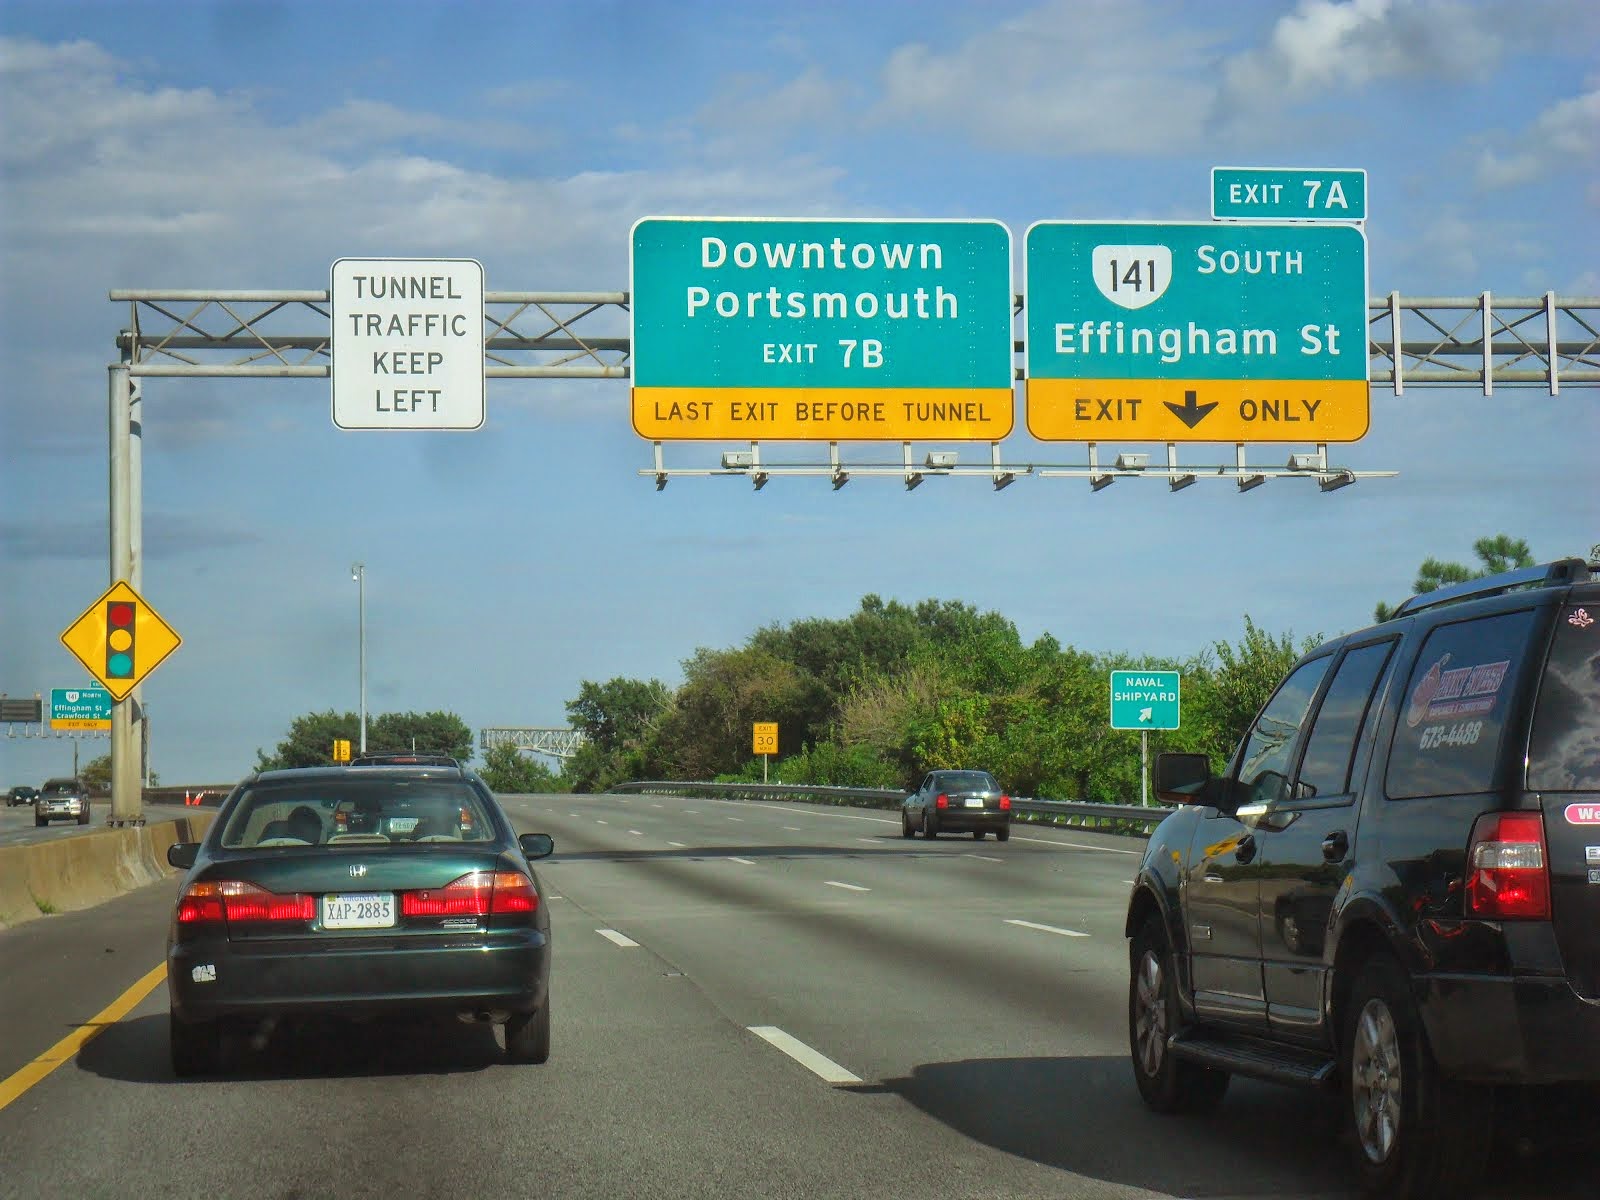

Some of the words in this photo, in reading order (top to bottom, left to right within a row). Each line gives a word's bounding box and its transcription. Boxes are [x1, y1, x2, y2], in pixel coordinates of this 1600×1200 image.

[1229, 183, 1283, 204] EXIT
[1303, 180, 1348, 209] 7A
[701, 236, 943, 269] Downtown
[1197, 245, 1303, 275] SOUTH
[353, 276, 462, 299] TUNNEL
[1110, 259, 1155, 292] 141
[687, 285, 959, 319] Portsmouth
[349, 313, 467, 337] TRAFFIC
[762, 343, 818, 363] EXIT
[838, 339, 884, 368] 7B
[1054, 320, 1277, 363] Effingham
[1300, 323, 1340, 355] St
[373, 351, 443, 375] KEEP
[376, 389, 441, 413] LEFT
[654, 402, 713, 421] LAST
[730, 402, 779, 421] EXIT
[796, 402, 886, 422] BEFORE
[902, 402, 991, 422] TUNNEL
[1075, 398, 1142, 421] EXIT
[1239, 399, 1322, 422] ONLY
[1126, 677, 1165, 687] NAVAL
[54, 704, 92, 713] Effingham
[1114, 692, 1176, 702] SHIPYARD
[757, 736, 774, 746] 30
[1420, 720, 1483, 750] 673-4488
[327, 902, 390, 920] XAP-2885
